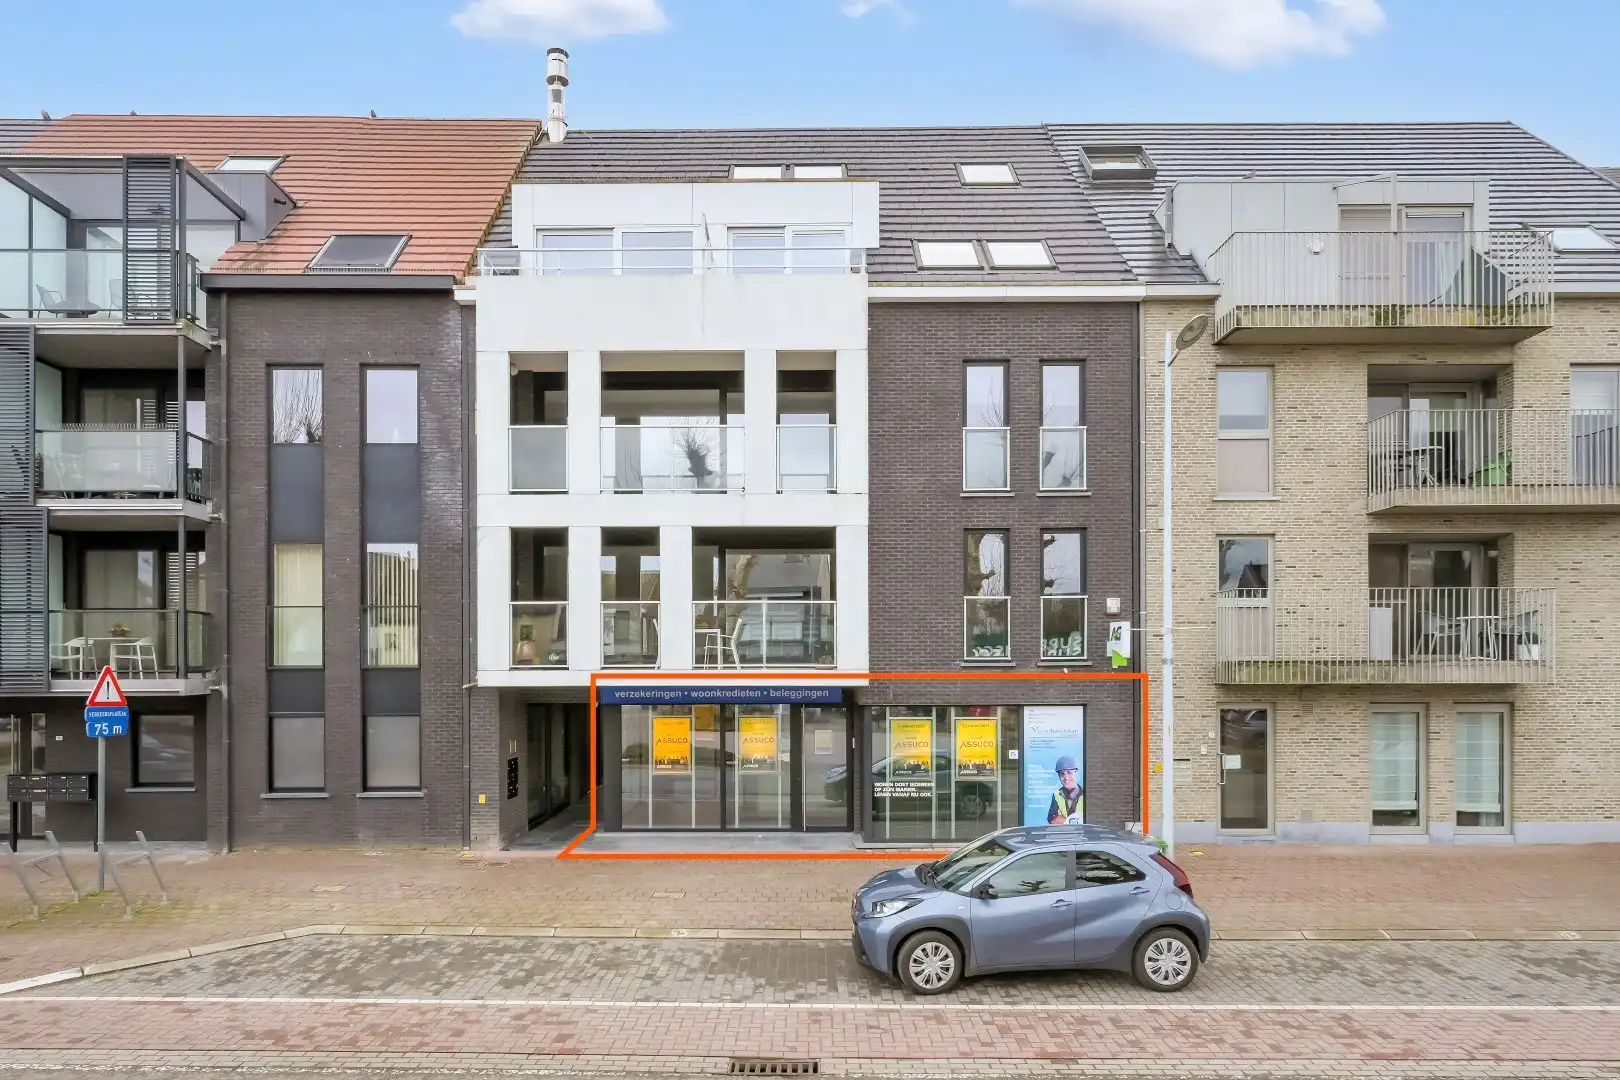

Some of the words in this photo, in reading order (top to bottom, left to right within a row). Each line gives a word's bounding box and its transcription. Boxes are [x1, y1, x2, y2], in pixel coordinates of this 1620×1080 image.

[614, 689, 682, 699] verzekeringen
[690, 689, 761, 698] woonkredieten
[769, 688, 829, 699] beleggingen
[94, 723, 109, 736] 75
[112, 725, 122, 735] m
[655, 737, 688, 745] ASSUCO
[894, 741, 929, 749] ASSUCO
[960, 741, 994, 749] ASSUCO
